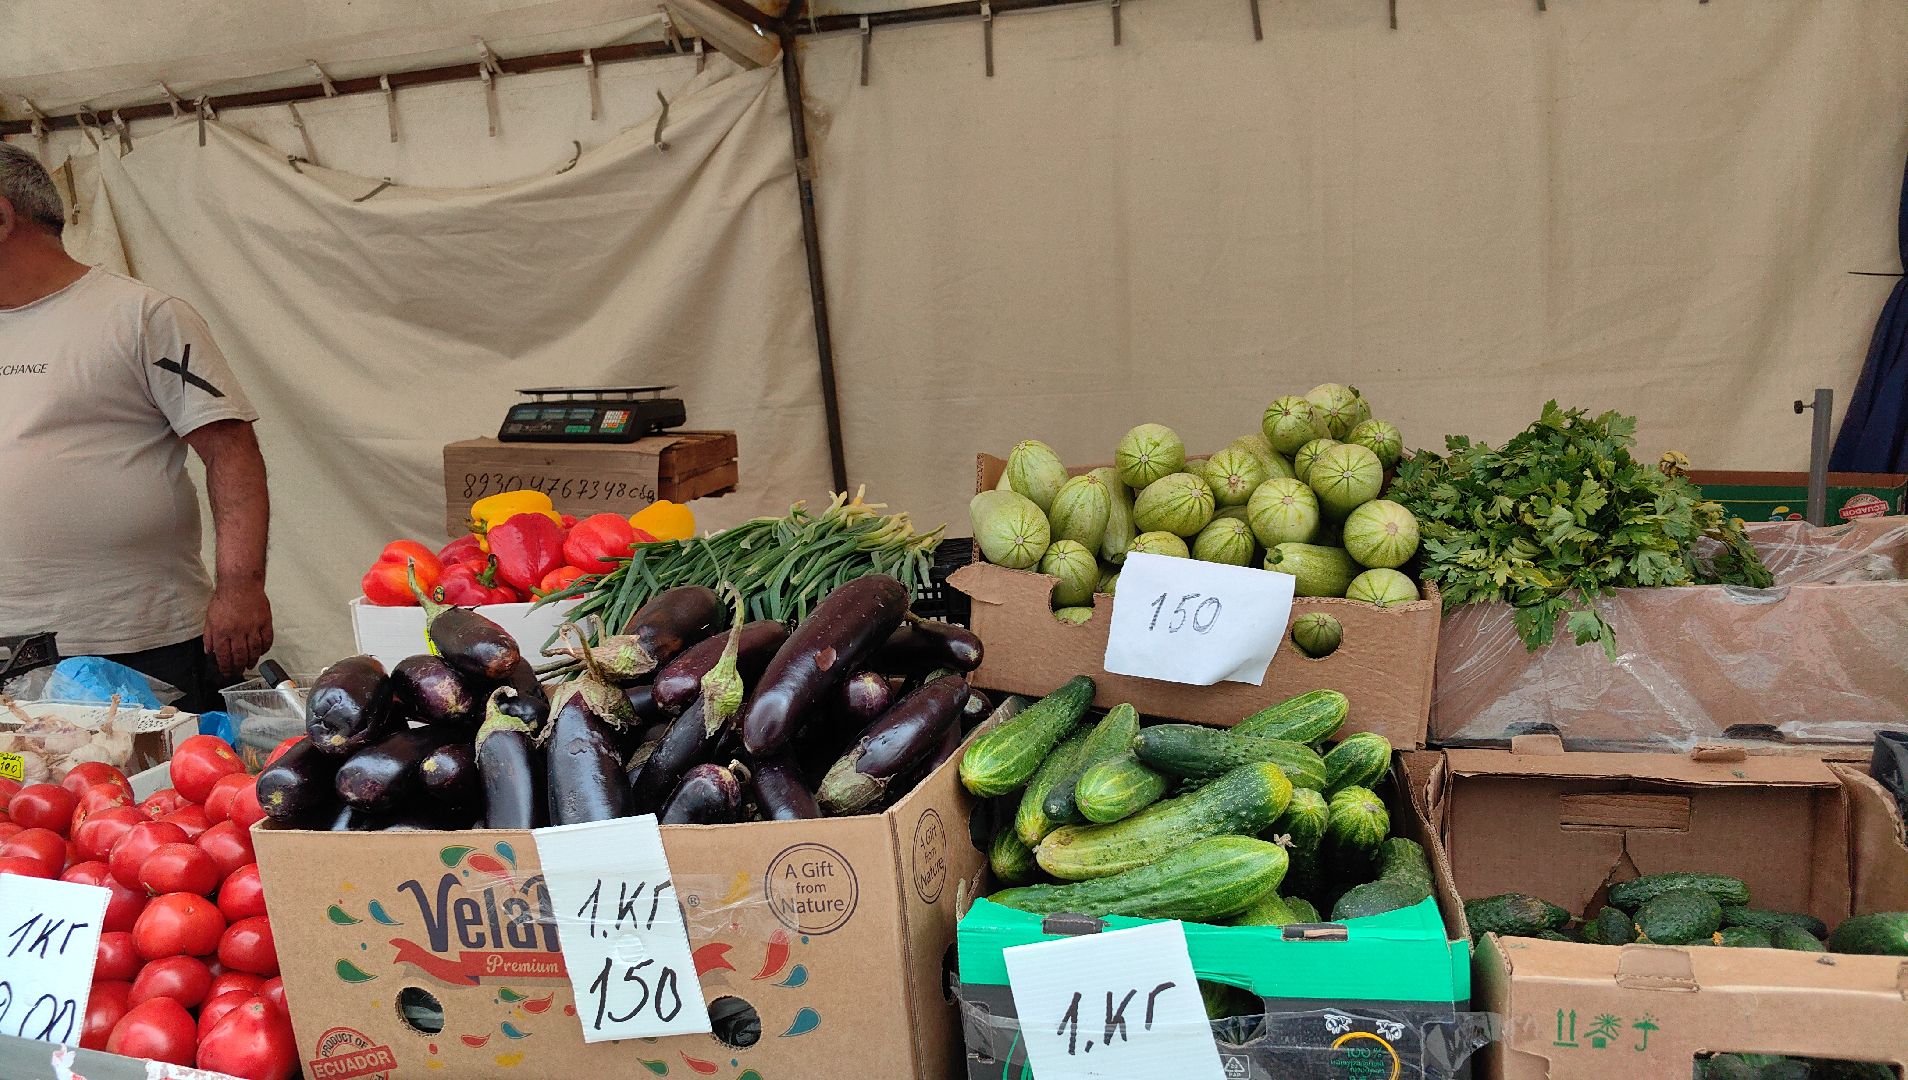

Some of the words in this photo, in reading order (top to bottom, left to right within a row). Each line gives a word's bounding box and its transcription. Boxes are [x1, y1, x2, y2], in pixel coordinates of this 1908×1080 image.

[1149, 593, 1222, 634] 150
[785, 864, 797, 879] A
[802, 861, 834, 878] Gift
[920, 857, 944, 889] Nature
[796, 882, 826, 894] from
[782, 898, 845, 914] Nature
[486, 954, 559, 974] Premium
[590, 957, 682, 1031] 150
[322, 1033, 353, 1058] PRODUCT
[355, 1037, 368, 1049] OF
[313, 1050, 391, 1079] ECUADOR
